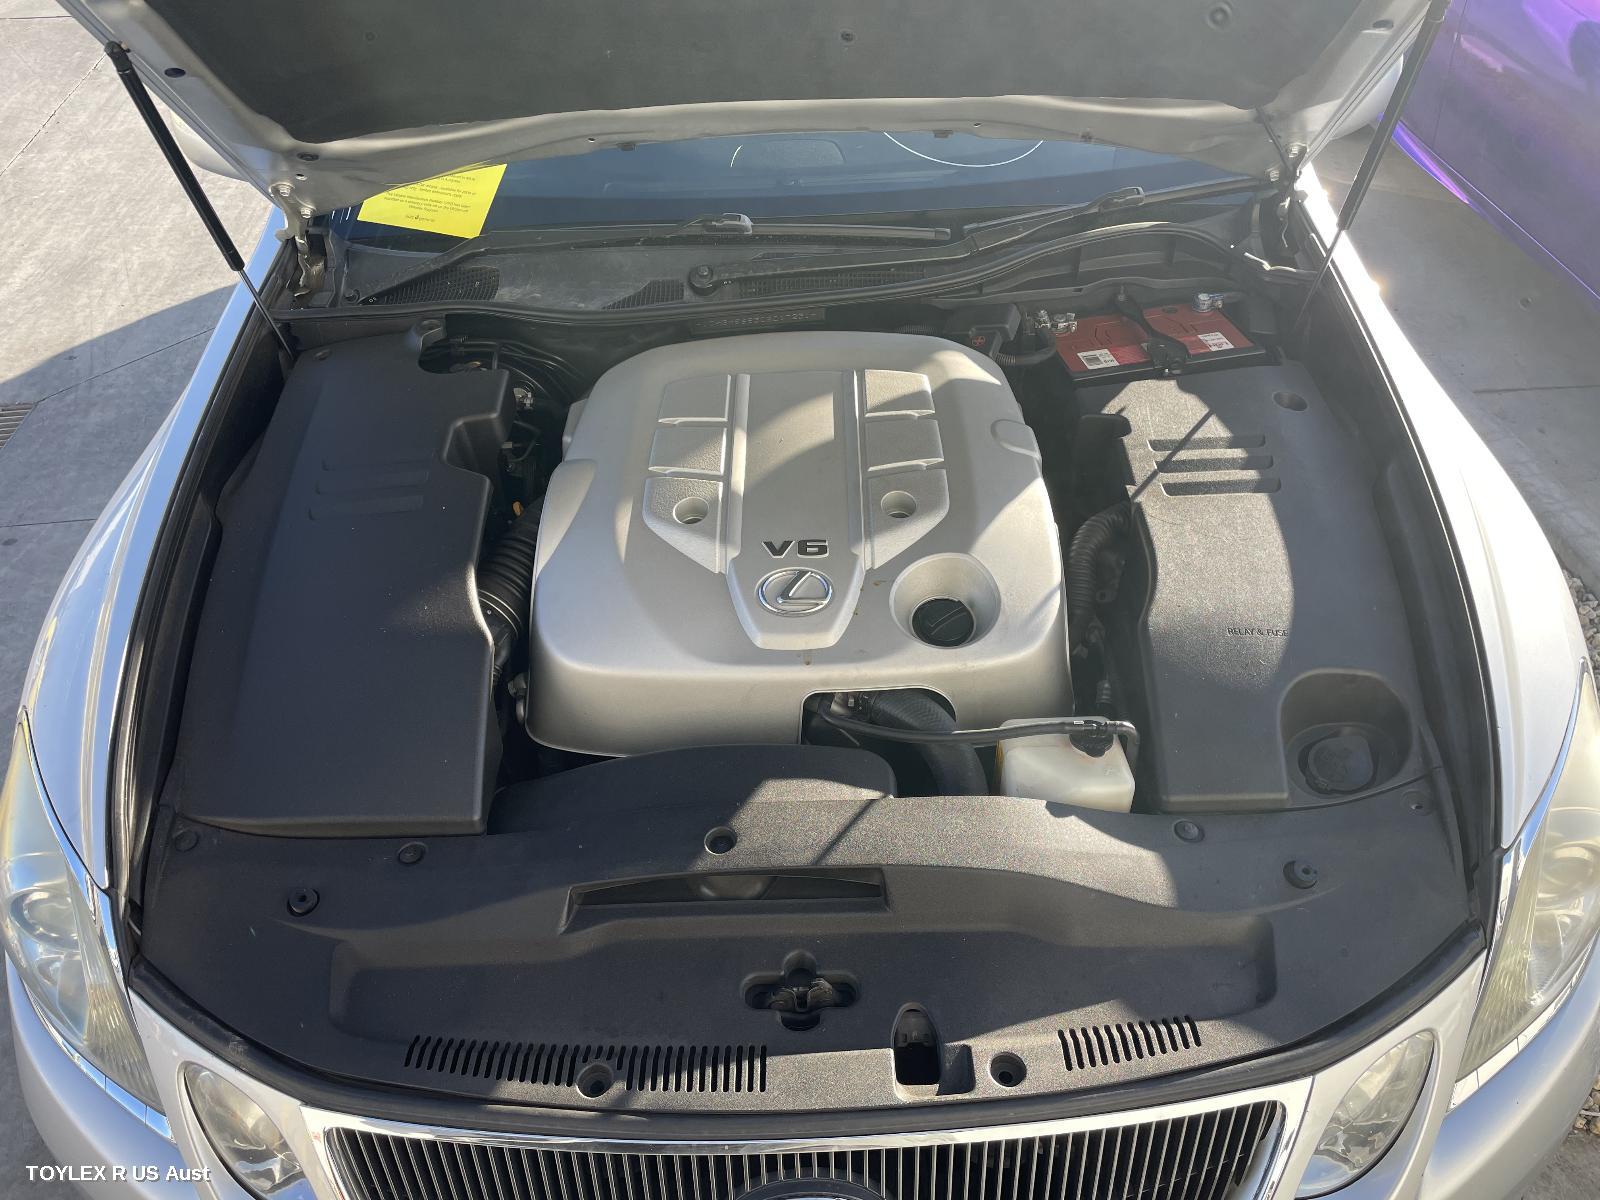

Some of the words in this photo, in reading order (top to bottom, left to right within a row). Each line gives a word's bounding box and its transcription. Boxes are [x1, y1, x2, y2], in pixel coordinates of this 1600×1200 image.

[761, 539, 829, 558] V6
[1227, 628, 1255, 636] RELAY
[1256, 628, 1264, 636] &
[1266, 629, 1289, 637] FUSE
